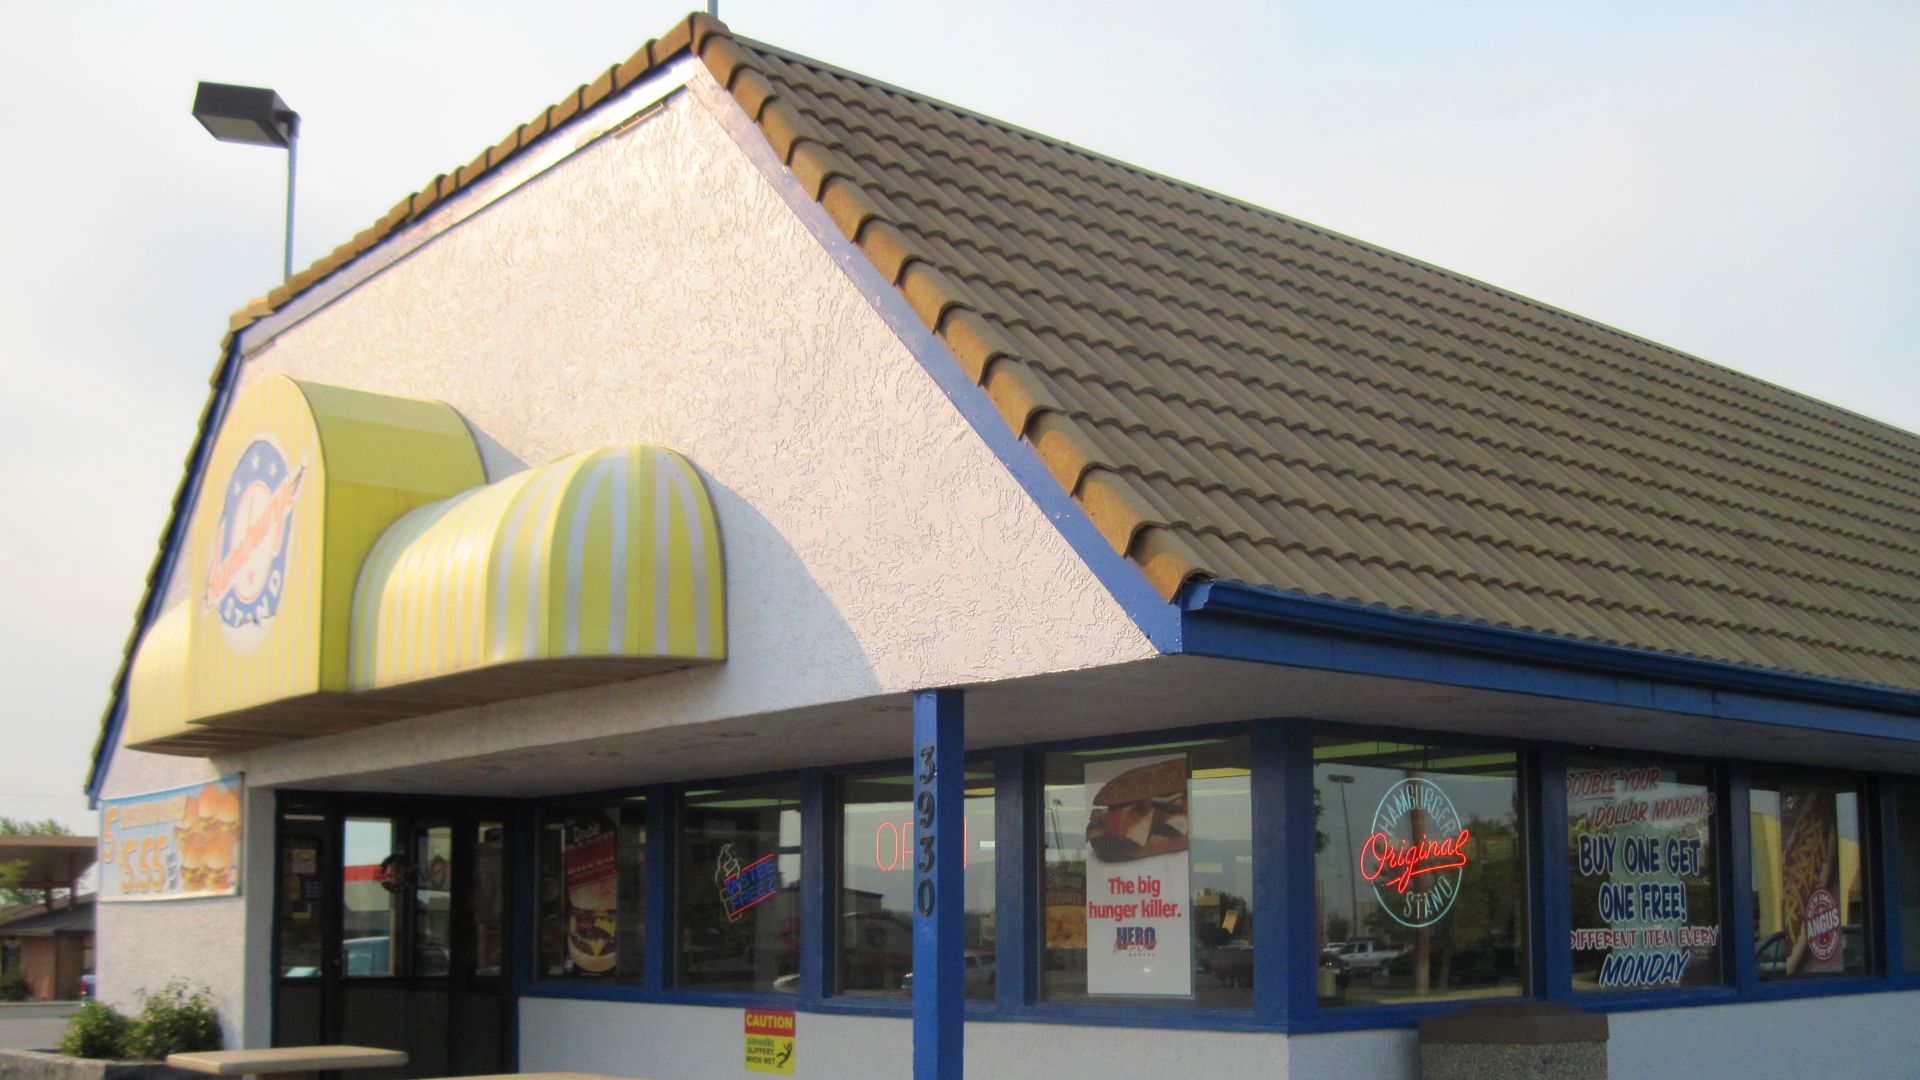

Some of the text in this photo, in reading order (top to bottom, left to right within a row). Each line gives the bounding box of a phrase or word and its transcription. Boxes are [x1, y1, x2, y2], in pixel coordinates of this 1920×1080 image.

[1623, 767, 1661, 791] YOUR
[1378, 784, 1458, 837] HAMBURGER
[1593, 793, 1717, 828] DOLLAR MONDAYS
[917, 745, 936, 917] 3930
[1361, 829, 1470, 893] Original
[1578, 833, 1702, 876] BUY ONE GET
[724, 858, 776, 893] TASTEE
[1108, 875, 1161, 898] The big
[1088, 899, 1182, 922] hunger killer.
[1403, 875, 1453, 920] STAND
[1599, 882, 1688, 922] ONE FREE!
[1116, 927, 1156, 951] HERO
[1643, 929, 1674, 946] ITEM
[1678, 925, 1719, 947] EVERY
[1807, 908, 1841, 939] ANGUS
[1599, 951, 1690, 988] MONDAY
[746, 1013, 793, 1029] CAUTION
[746, 1055, 776, 1064] WHEN WET
[747, 1047, 774, 1056] SLIPPERY
